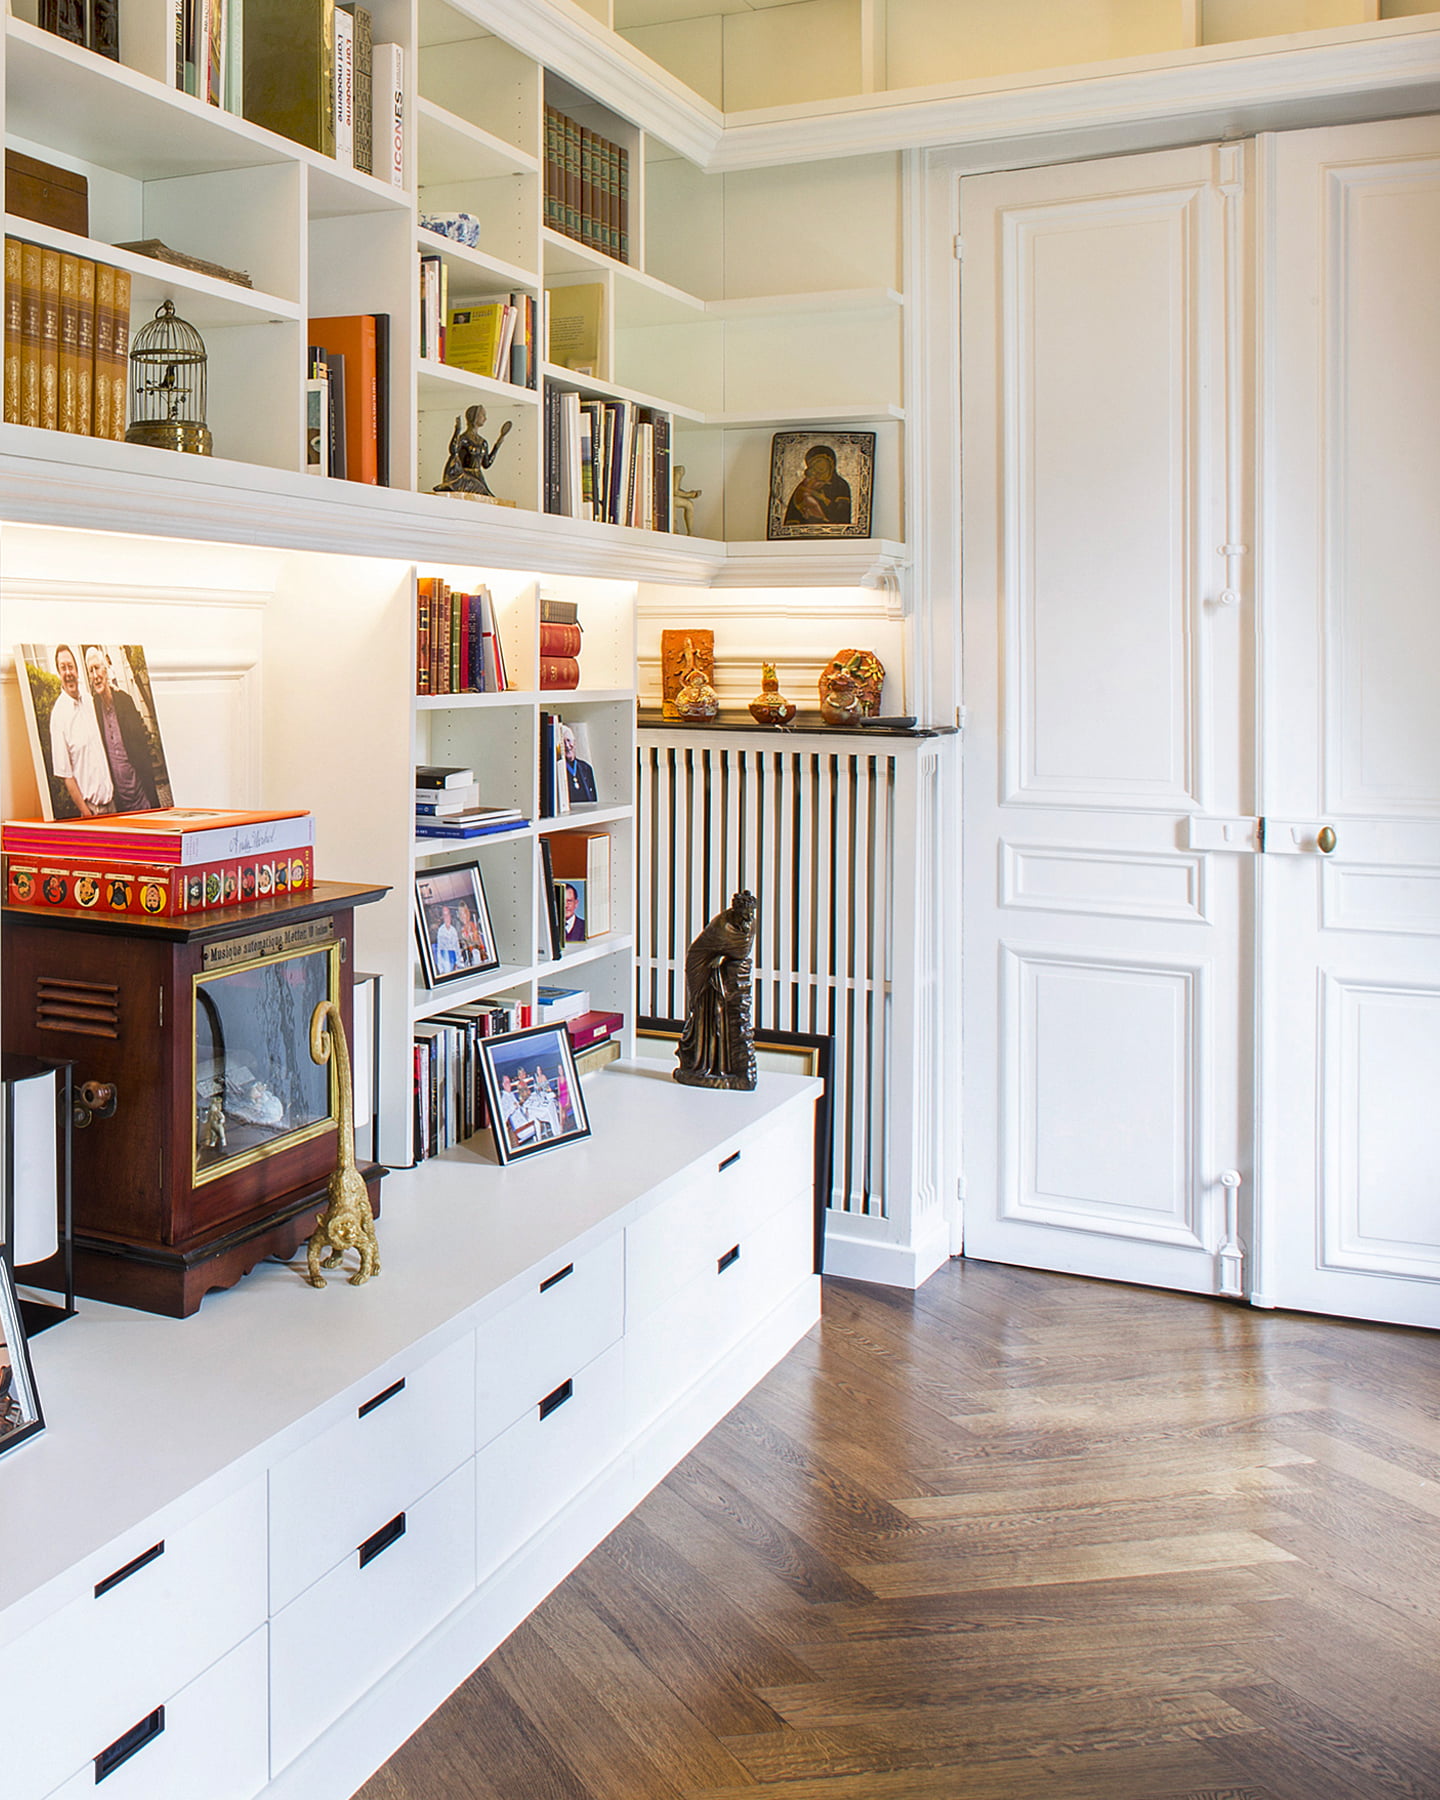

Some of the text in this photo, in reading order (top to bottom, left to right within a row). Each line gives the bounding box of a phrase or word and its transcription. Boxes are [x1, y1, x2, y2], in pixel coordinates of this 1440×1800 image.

[175, 15, 183, 46] ANDY
[393, 90, 402, 173] ICONES
[210, 935, 283, 962] Musique automatique
